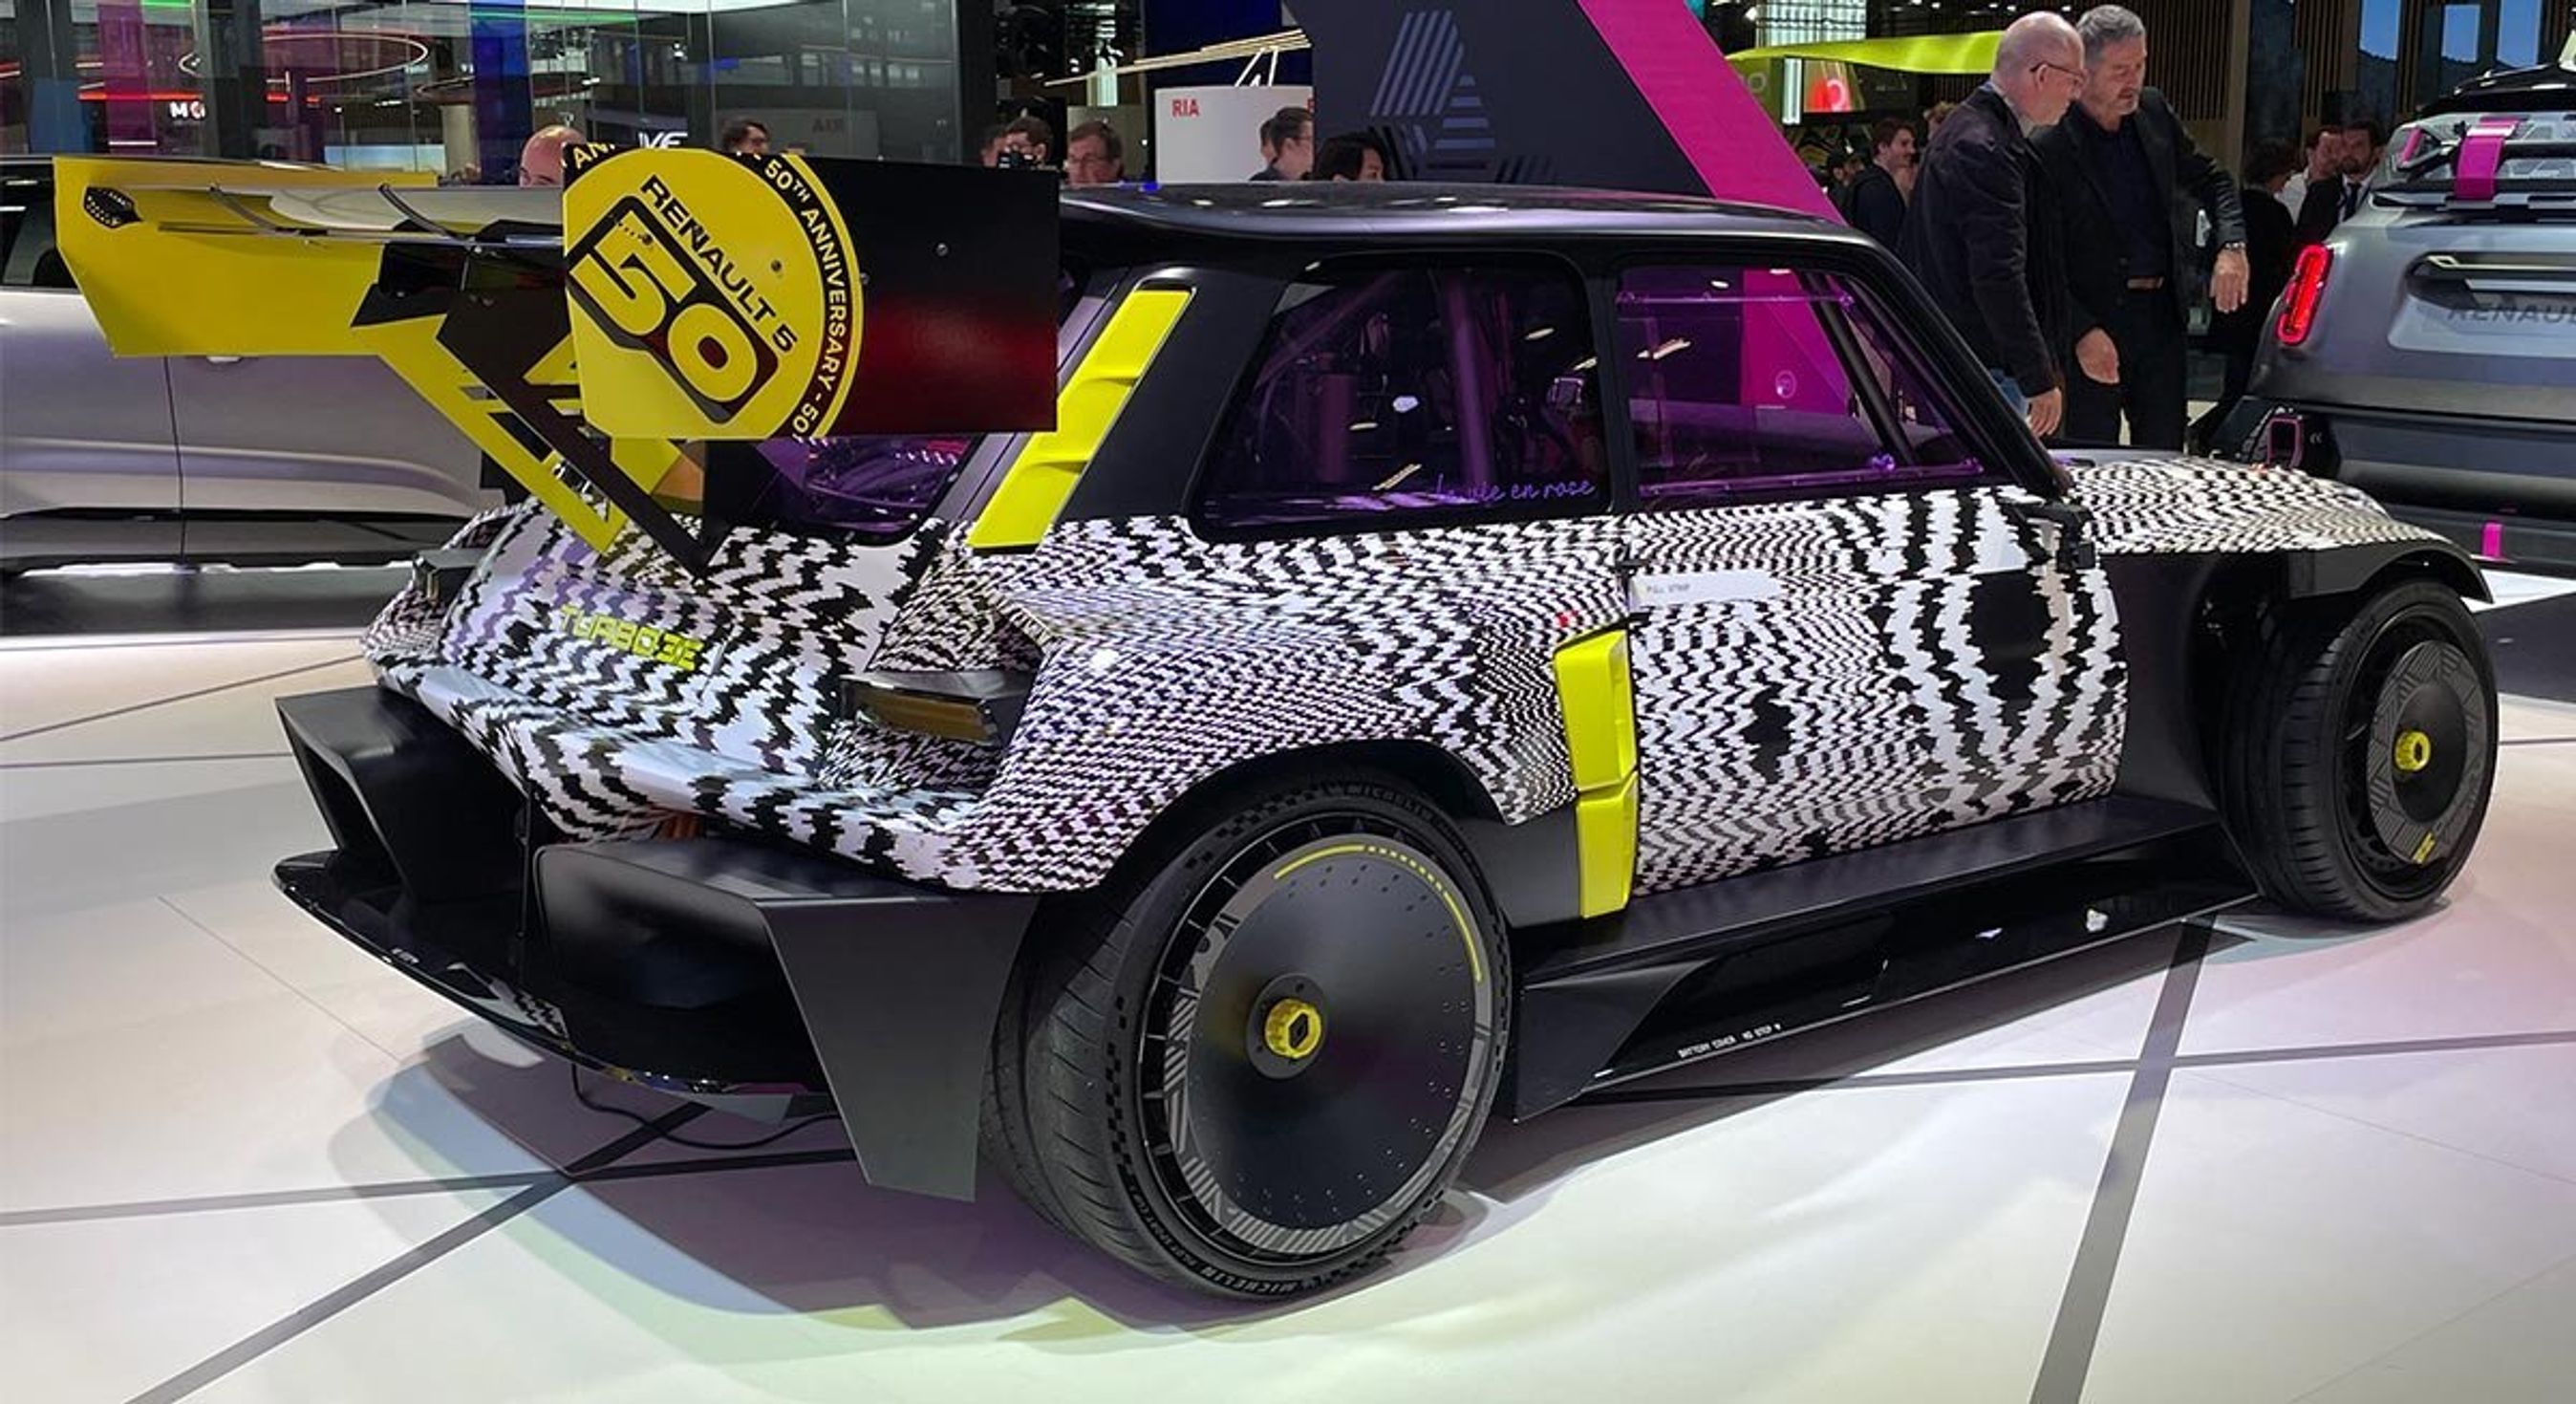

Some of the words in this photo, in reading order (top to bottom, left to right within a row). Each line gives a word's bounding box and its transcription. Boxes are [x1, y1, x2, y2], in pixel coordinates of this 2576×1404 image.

[1171, 98, 1200, 118] RIA
[569, 209, 758, 402] 50
[639, 174, 777, 323] RENAULT
[772, 323, 799, 354] 5
[764, 159, 811, 203] 50TH
[801, 207, 848, 392] ANNIVERSARY
[1201, 1265, 1299, 1293] MICHELIN
